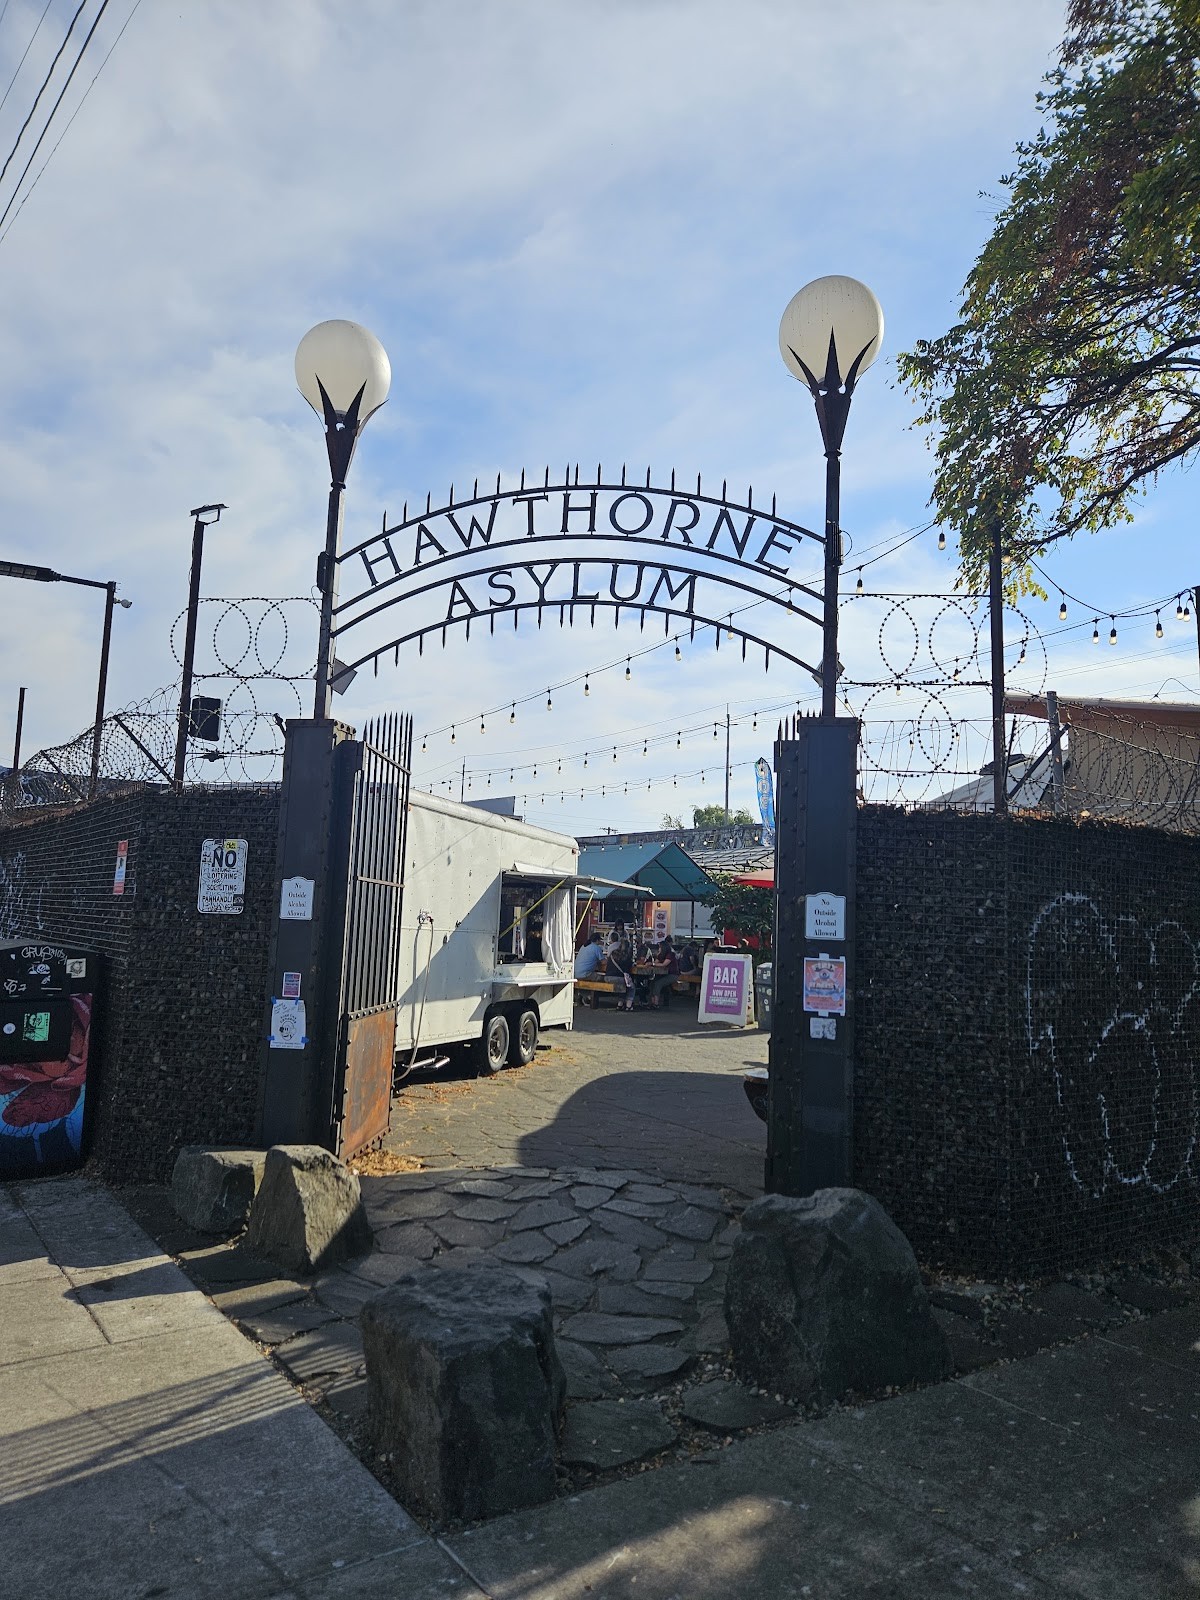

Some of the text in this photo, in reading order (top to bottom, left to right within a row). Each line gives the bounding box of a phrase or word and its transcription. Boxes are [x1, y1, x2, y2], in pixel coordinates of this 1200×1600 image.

[358, 491, 803, 587] HAWTHORNE
[446, 562, 698, 620] ASYLUM
[211, 848, 237, 868] NO
[206, 884, 237, 892] SOLCITING
[202, 895, 234, 903] PANHANDLI
[821, 898, 830, 906] No
[814, 919, 837, 927] Alcohol
[814, 929, 837, 937] Allowed
[713, 966, 739, 985] BAR
[712, 989, 723, 998] NOW
[724, 990, 737, 998] OPEN
